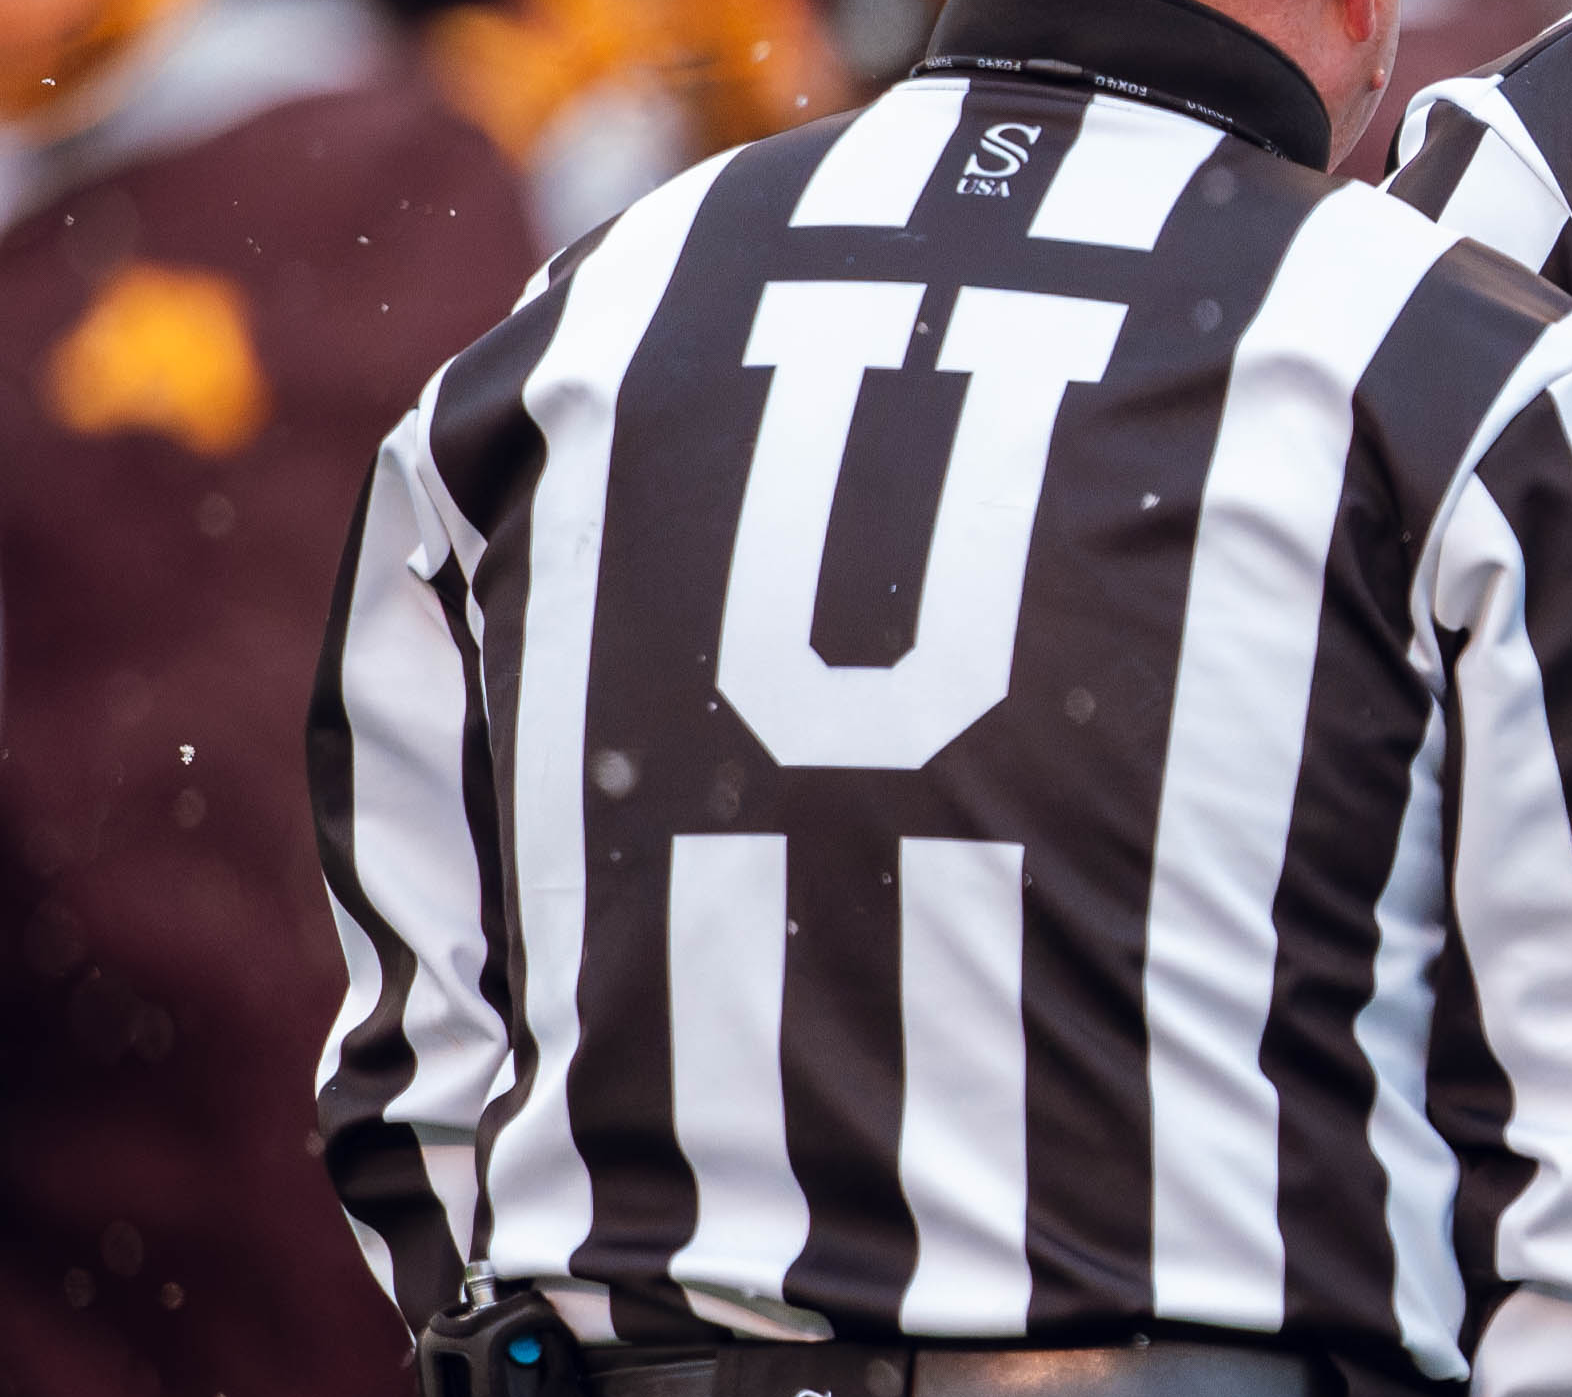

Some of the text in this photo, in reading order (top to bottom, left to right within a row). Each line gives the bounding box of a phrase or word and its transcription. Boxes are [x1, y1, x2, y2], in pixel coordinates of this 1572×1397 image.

[975, 58, 1022, 72] FOX40
[1094, 74, 1148, 96] FOX40
[956, 177, 1011, 198] USA
[714, 279, 1130, 771] U
